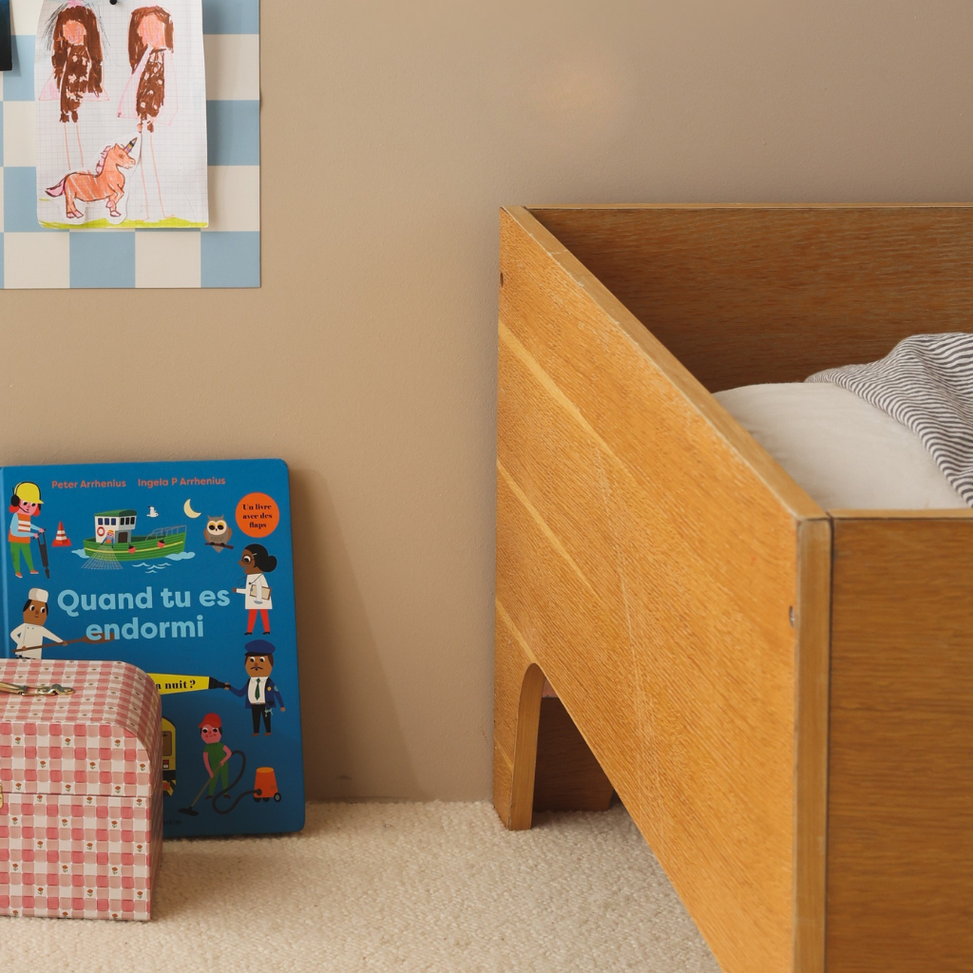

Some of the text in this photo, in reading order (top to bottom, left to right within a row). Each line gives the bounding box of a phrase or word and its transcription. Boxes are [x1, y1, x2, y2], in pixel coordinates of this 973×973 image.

[51, 475, 226, 489] Peter Arrhenius Ingela P Arrhenius
[242, 503, 254, 511] Un
[249, 521, 267, 530] flaps
[57, 586, 231, 618] Quand tu es
[85, 614, 204, 641] endormi
[164, 679, 187, 690] nuit
